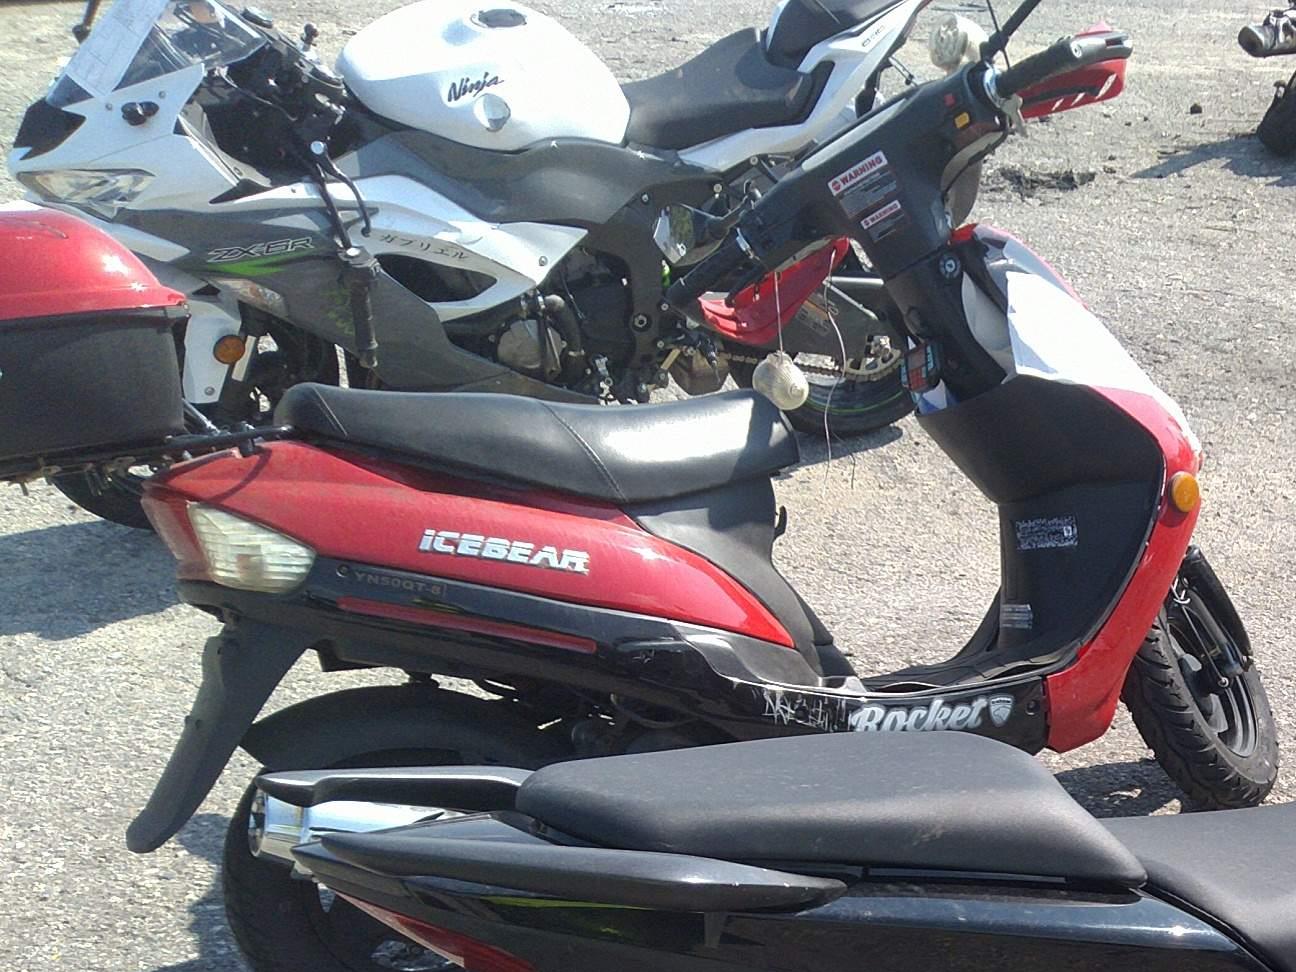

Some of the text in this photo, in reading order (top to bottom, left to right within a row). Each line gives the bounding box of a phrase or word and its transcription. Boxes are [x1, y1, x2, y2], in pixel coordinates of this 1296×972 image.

[448, 71, 505, 102] Ninja
[840, 156, 883, 185] WARNING
[207, 236, 315, 262] ZX-6R
[419, 528, 591, 575] ICEBEAR
[850, 697, 988, 731] Rocket
